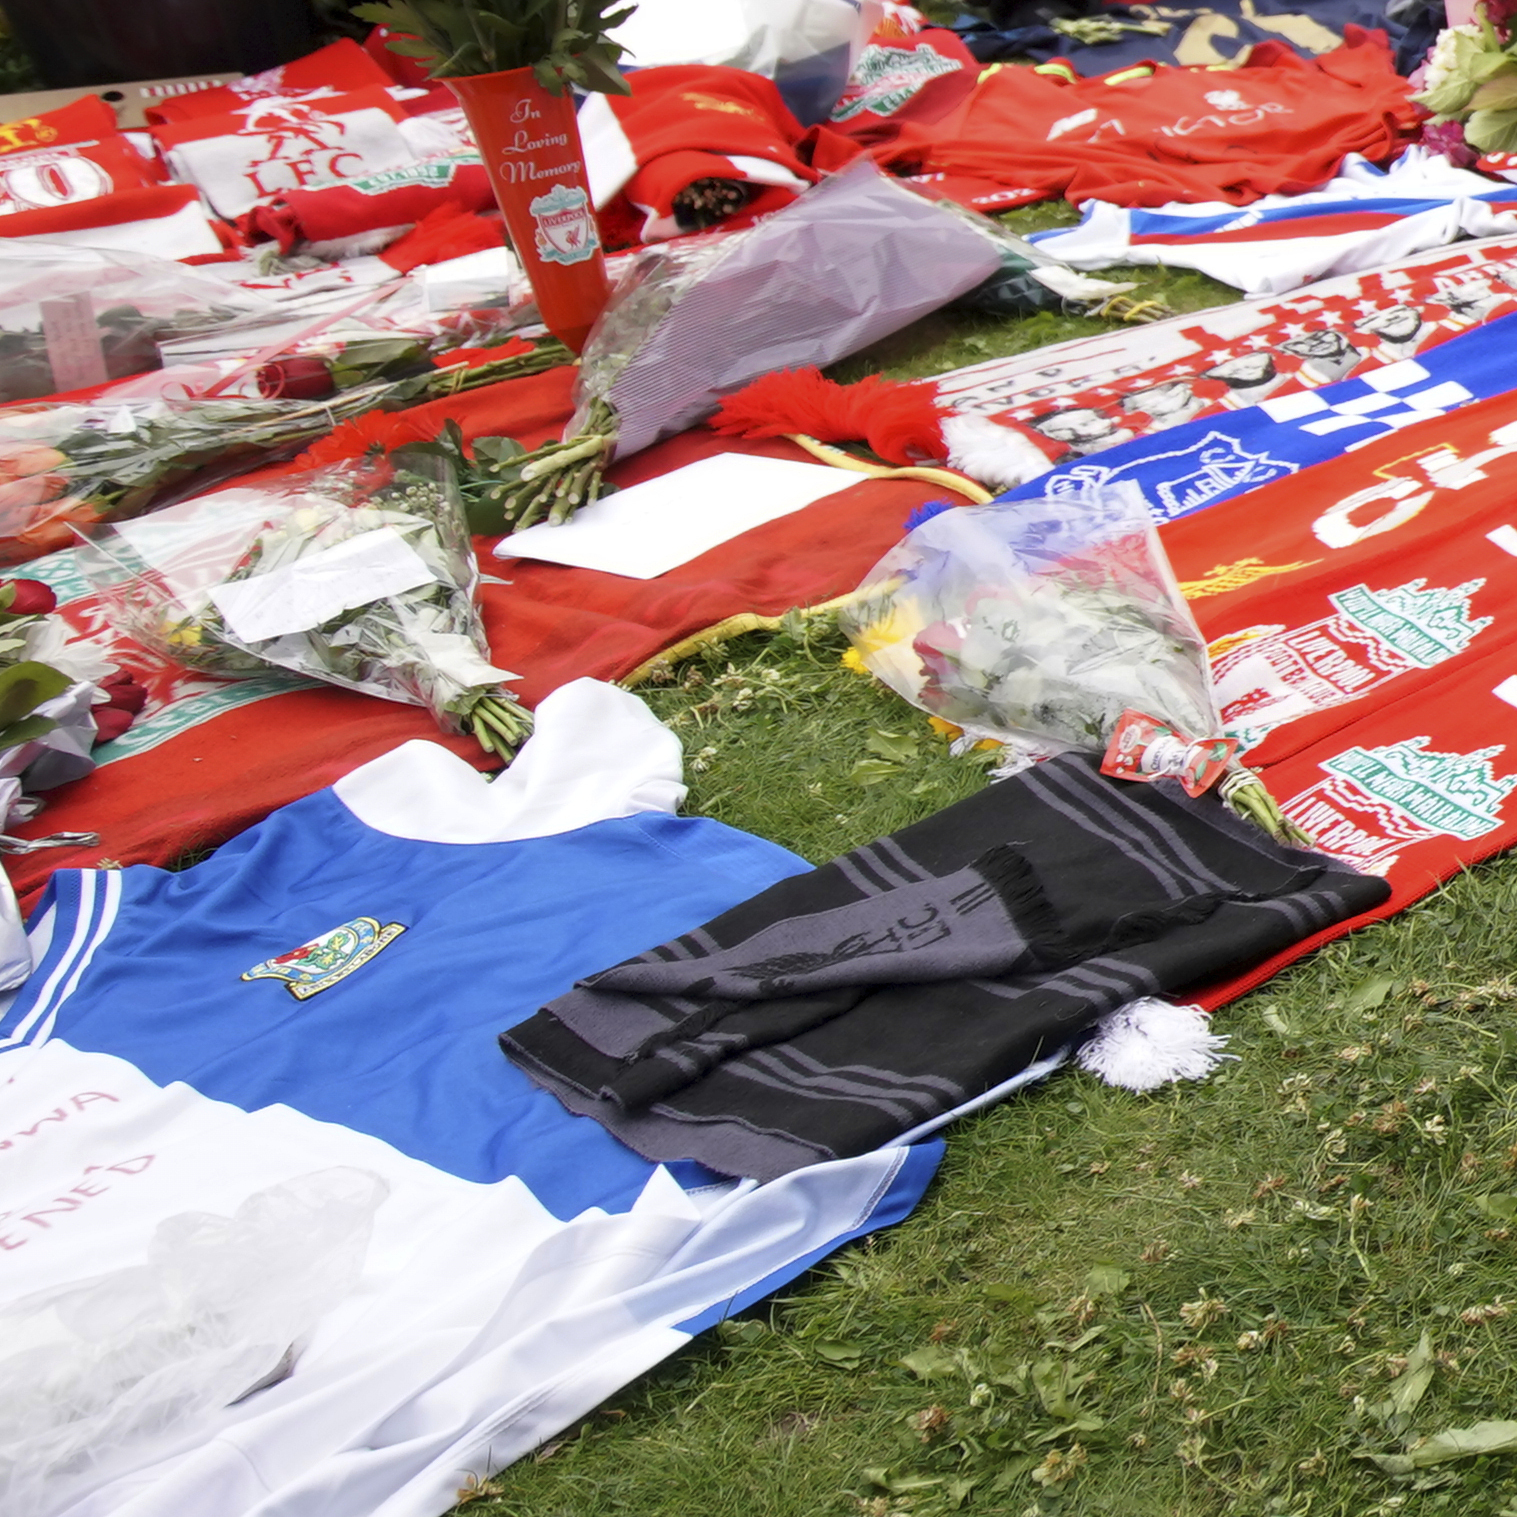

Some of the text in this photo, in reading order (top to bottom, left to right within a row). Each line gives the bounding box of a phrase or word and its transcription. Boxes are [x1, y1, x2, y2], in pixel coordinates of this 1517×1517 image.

[510, 98, 541, 124] In
[502, 130, 568, 156] Loving
[500, 158, 582, 184] Memory
